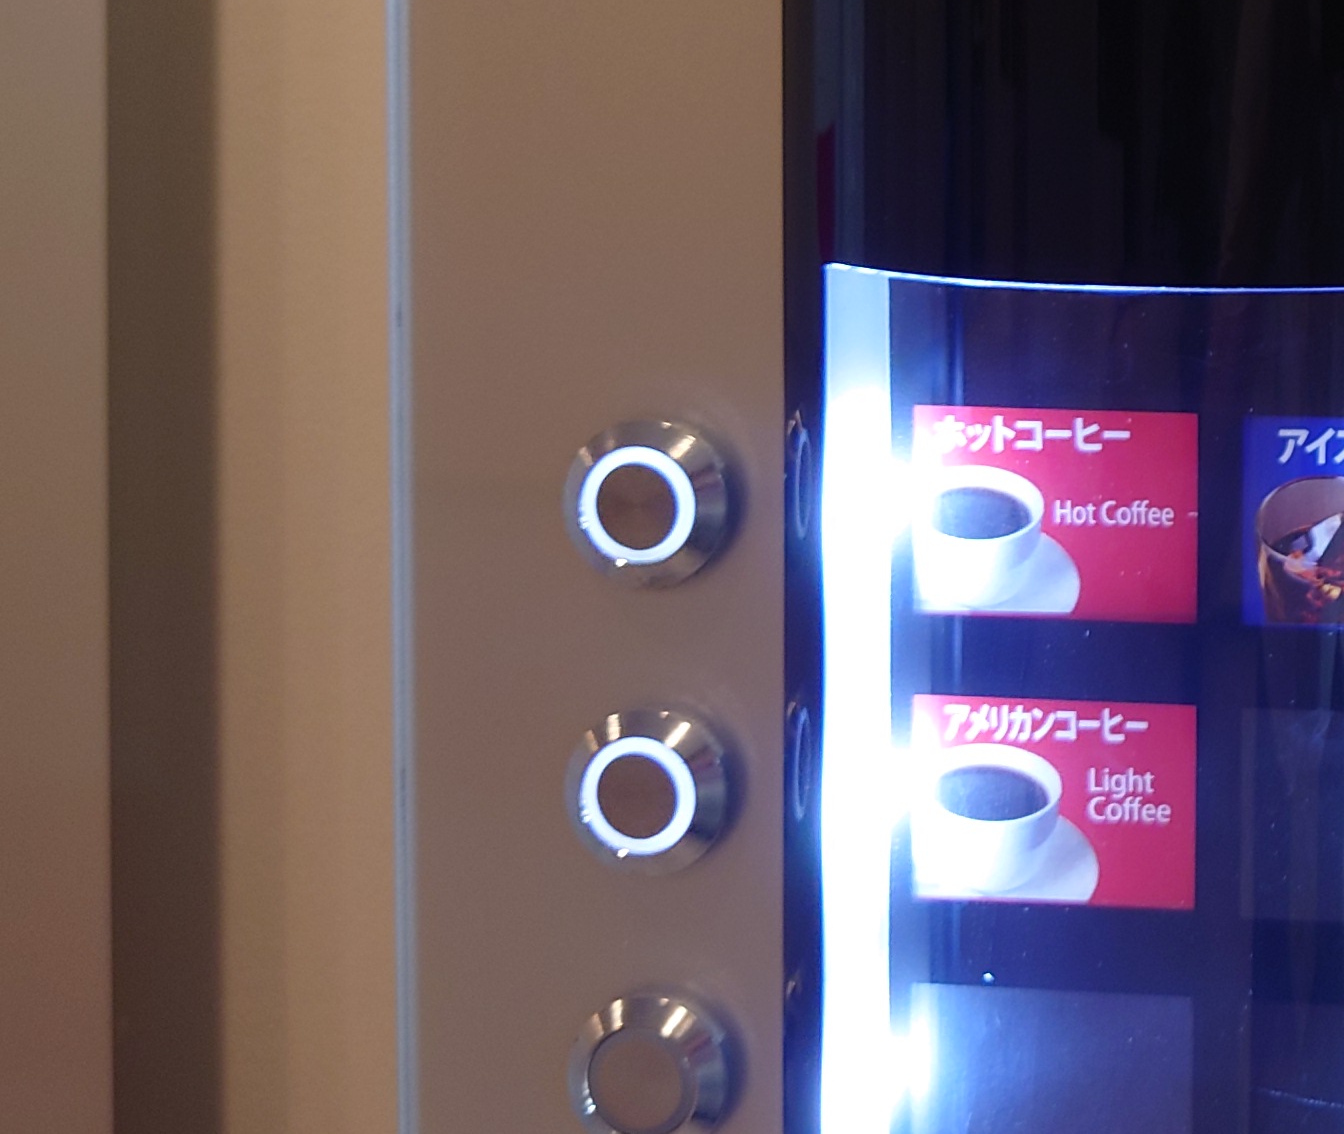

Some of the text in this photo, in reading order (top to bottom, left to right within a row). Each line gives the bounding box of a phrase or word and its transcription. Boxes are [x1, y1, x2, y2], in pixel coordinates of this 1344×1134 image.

[932, 414, 1131, 454] ホットコーヒー
[1053, 499, 1175, 528] Hot Coffee
[943, 703, 1148, 745] アメリカンコーヒー
[1088, 767, 1155, 797] Light
[1087, 796, 1172, 826] Coffee
